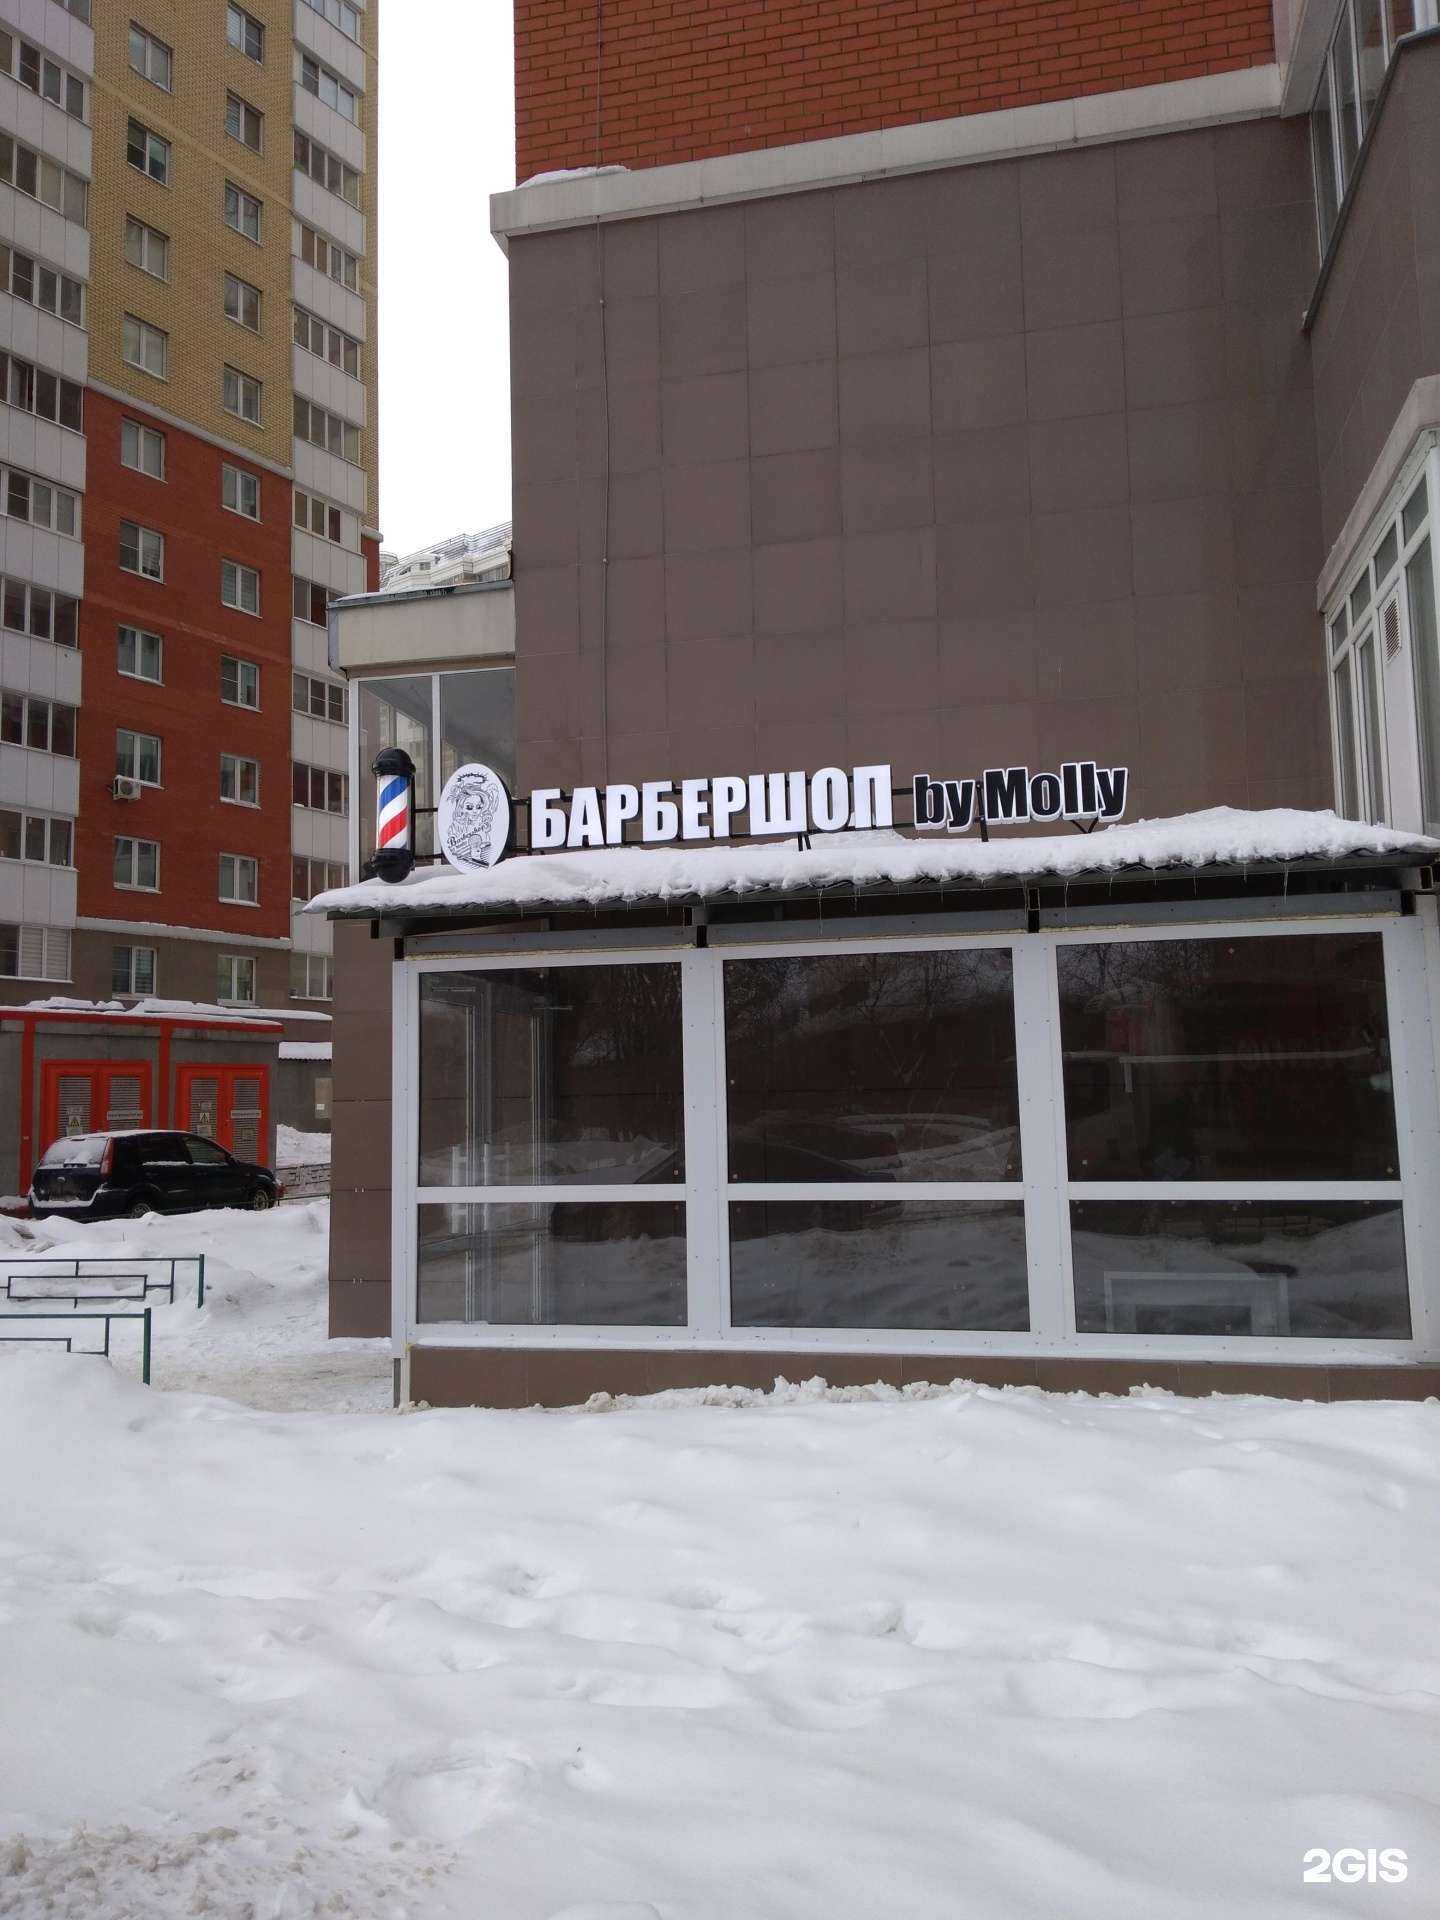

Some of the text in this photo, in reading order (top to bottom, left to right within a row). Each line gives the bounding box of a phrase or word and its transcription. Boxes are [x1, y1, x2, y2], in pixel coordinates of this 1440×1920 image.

[531, 761, 1128, 849] БАРБЕРШОП by Molly
